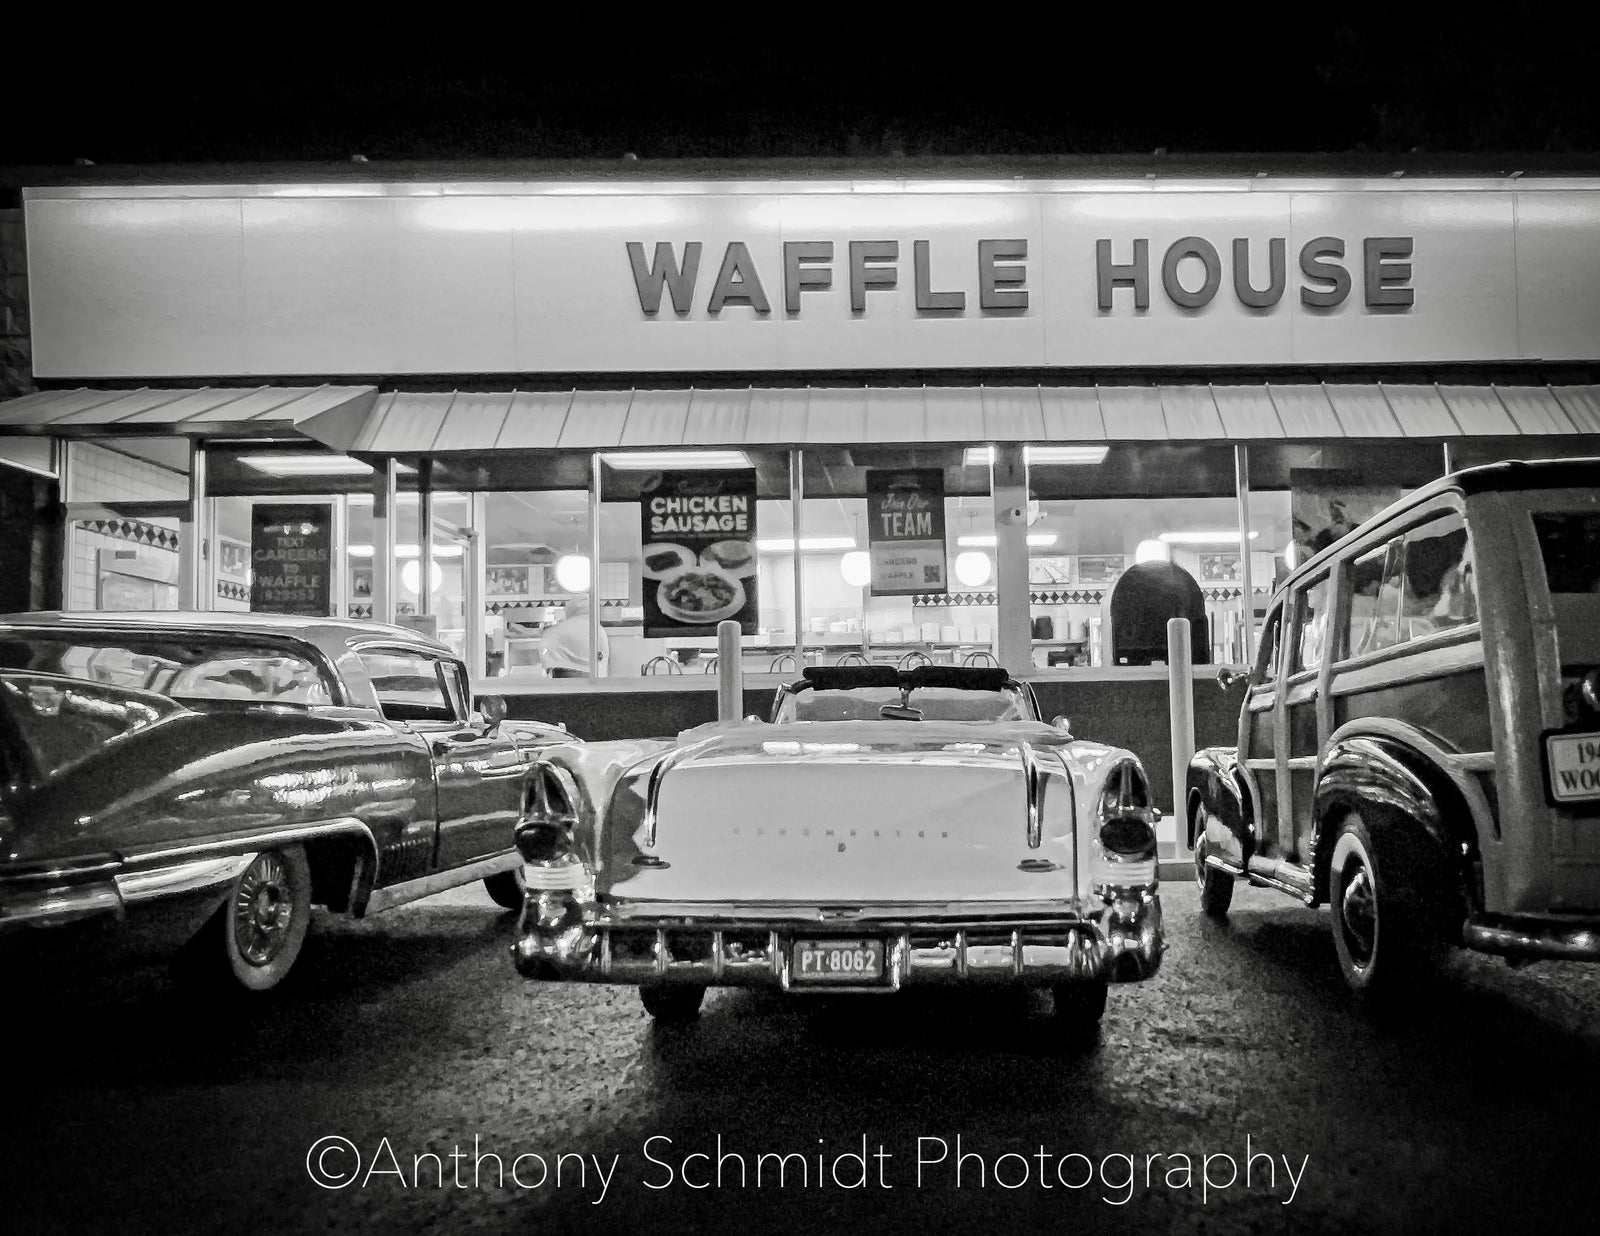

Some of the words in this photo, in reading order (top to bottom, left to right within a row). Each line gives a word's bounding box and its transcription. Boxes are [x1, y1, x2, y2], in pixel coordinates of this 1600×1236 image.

[626, 237, 1029, 314] WAFFLE
[1096, 236, 1415, 313] HOUSE
[650, 495, 748, 514] CHICKEN
[651, 514, 748, 534] SAUSAGE
[881, 512, 932, 536] TEAM
[258, 575, 320, 588] WAFFLE
